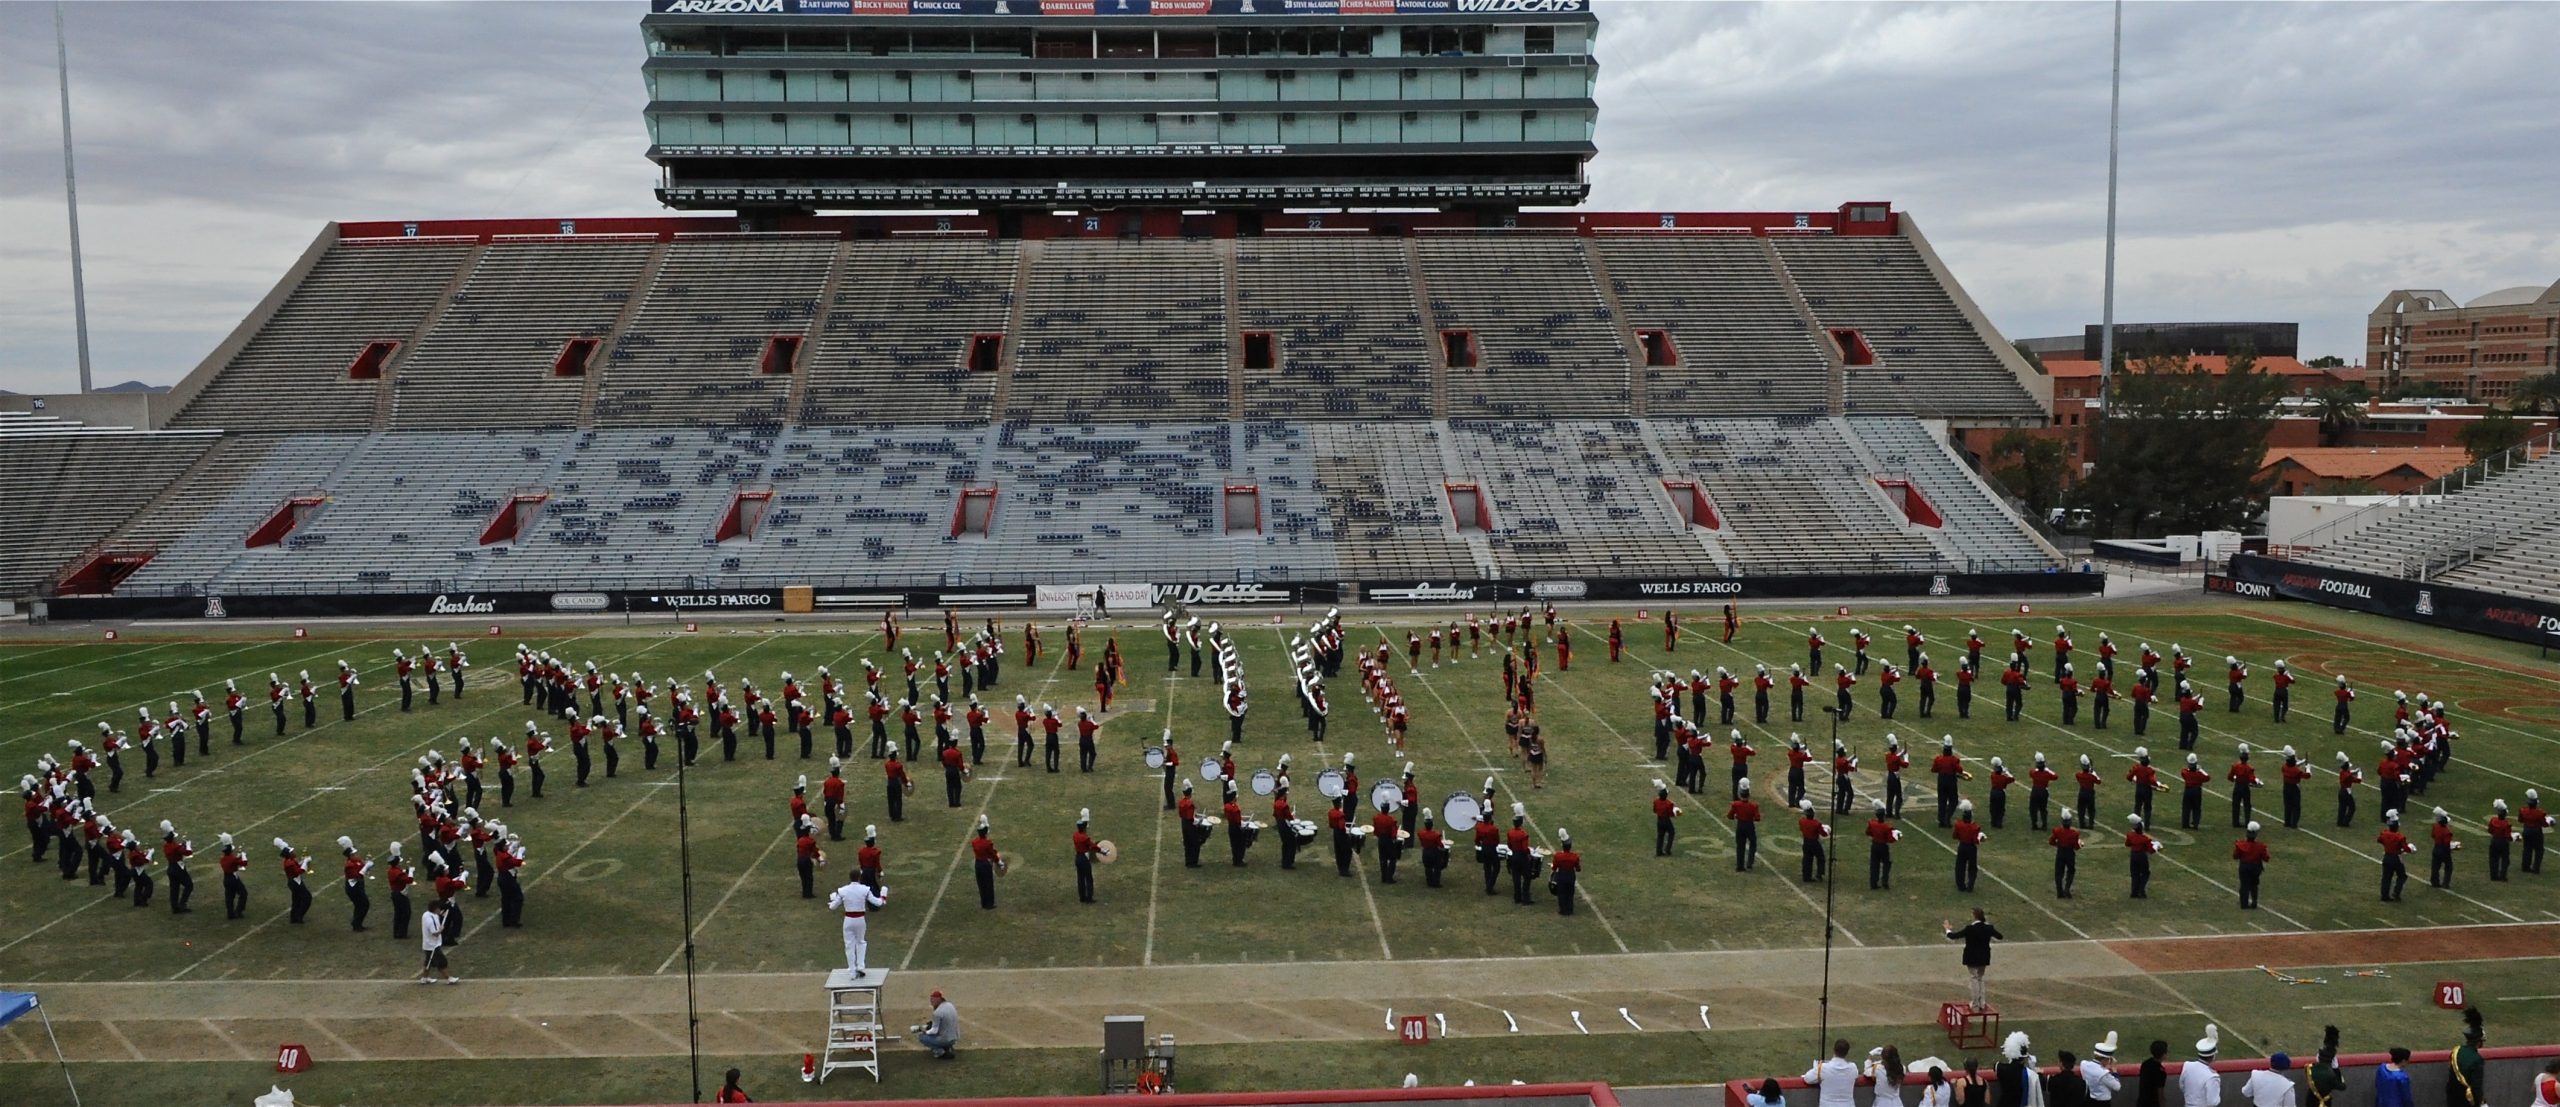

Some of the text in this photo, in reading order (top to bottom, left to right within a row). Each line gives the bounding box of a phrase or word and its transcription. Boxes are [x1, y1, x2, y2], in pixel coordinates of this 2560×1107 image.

[666, 0, 784, 13] ARIZONA
[1075, 2, 1095, 10] LEWIS
[1457, 0, 1583, 11] WILDCATS
[938, 222, 951, 231] 20
[1087, 220, 1099, 230] 21
[1309, 220, 1321, 230] 22
[1504, 219, 1517, 228] 23
[1662, 220, 1674, 230] 24
[1796, 220, 1808, 230] 25
[406, 228, 416, 237] 17
[562, 227, 575, 236] 18
[34, 399, 45, 409] 16
[1640, 583, 1742, 594] WELLS FARGO
[2208, 577, 2271, 597] BEAR DOWN
[2319, 579, 2372, 598] FOOTBALL
[664, 595, 771, 606] WELLS FARGO
[1039, 592, 1074, 602] UNIVERSITY
[1115, 592, 1134, 601] BAND
[1135, 592, 1148, 600] DAY
[429, 595, 497, 614] Bashas'
[2485, 607, 2540, 627] ARIZONA
[2443, 987, 2463, 1004] 20
[1405, 1020, 1423, 1040] 40
[279, 1049, 298, 1069] 40
